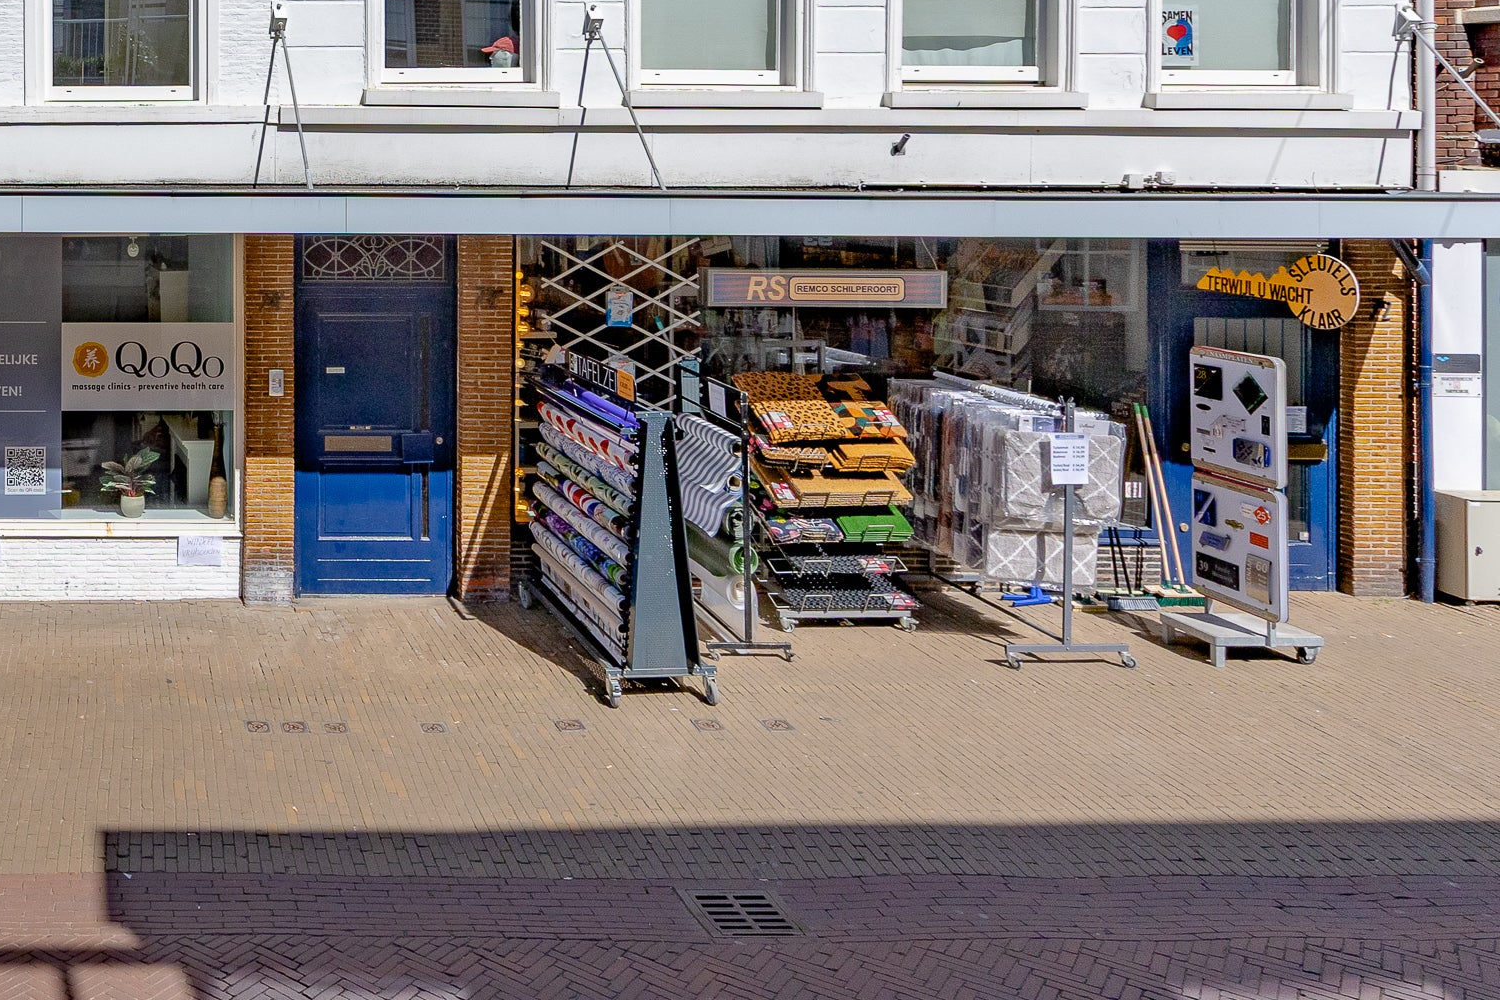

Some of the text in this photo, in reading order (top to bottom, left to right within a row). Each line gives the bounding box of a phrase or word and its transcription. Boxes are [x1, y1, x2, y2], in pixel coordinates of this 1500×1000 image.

[1162, 10, 1193, 25] SAMEN
[1162, 42, 1194, 56] LEVEN
[1288, 255, 1357, 297] SLEUTELS
[746, 275, 787, 301] RS
[796, 285, 898, 293] REMCO SCHILPEROORT
[1206, 275, 1314, 305] TERWIJL U WACHT
[1299, 305, 1345, 329] KLAAR
[578, 355, 617, 393] TAFELZEI
[1196, 370, 1207, 379] 28
[72, 383, 106, 392] massage
[108, 382, 131, 390] clinics
[138, 382, 179, 392] preventive
[181, 382, 206, 390] health
[1256, 510, 1266, 520] 25
[1199, 560, 1209, 572] 39
[1255, 562, 1268, 573] 60
